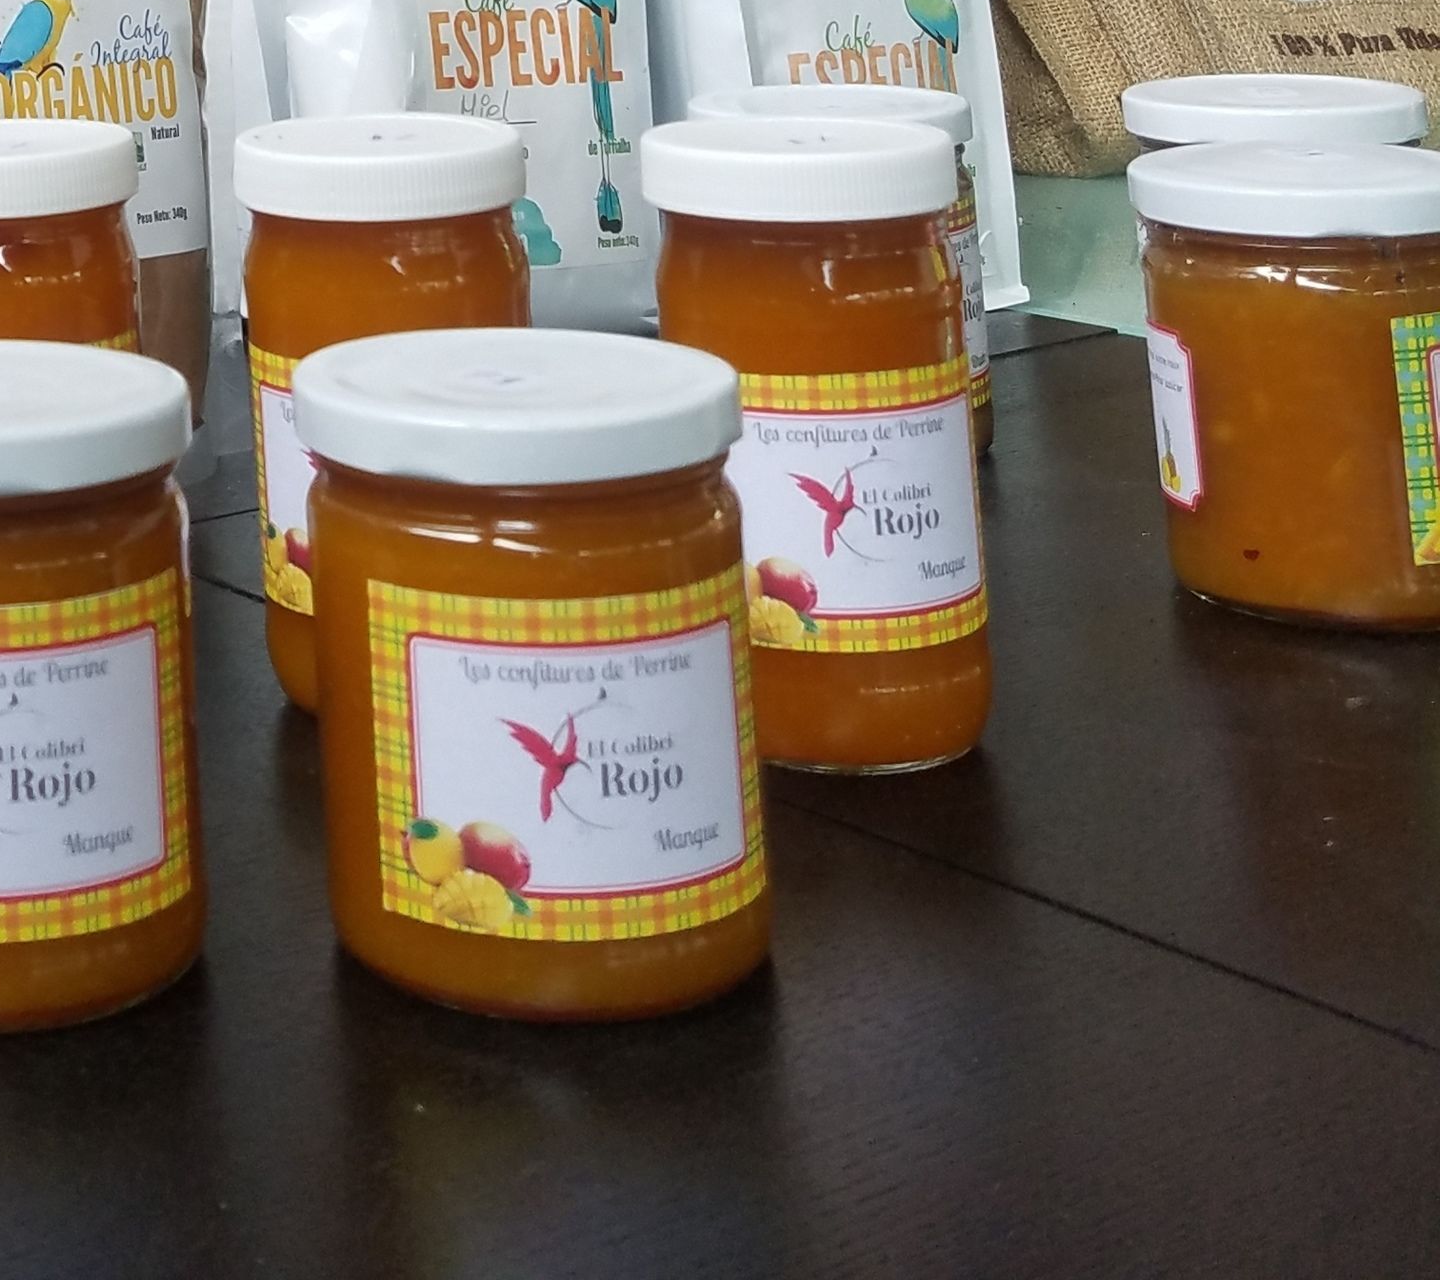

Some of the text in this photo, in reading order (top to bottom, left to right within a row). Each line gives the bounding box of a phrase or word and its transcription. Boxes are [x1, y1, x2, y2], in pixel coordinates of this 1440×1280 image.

[119, 8, 164, 45] Café
[825, 14, 876, 53] Café
[90, 30, 173, 73] Integral
[461, 89, 509, 122] Miel
[150, 122, 181, 141] Natural
[785, 423, 868, 449] confitures
[872, 421, 892, 441] de
[896, 415, 945, 438] Perrine
[873, 502, 941, 540] Rojo
[14, 666, 38, 687] de
[497, 659, 597, 690] confitures
[602, 659, 624, 682] de
[9, 761, 96, 807] Rojo
[599, 758, 685, 803] Rojo
